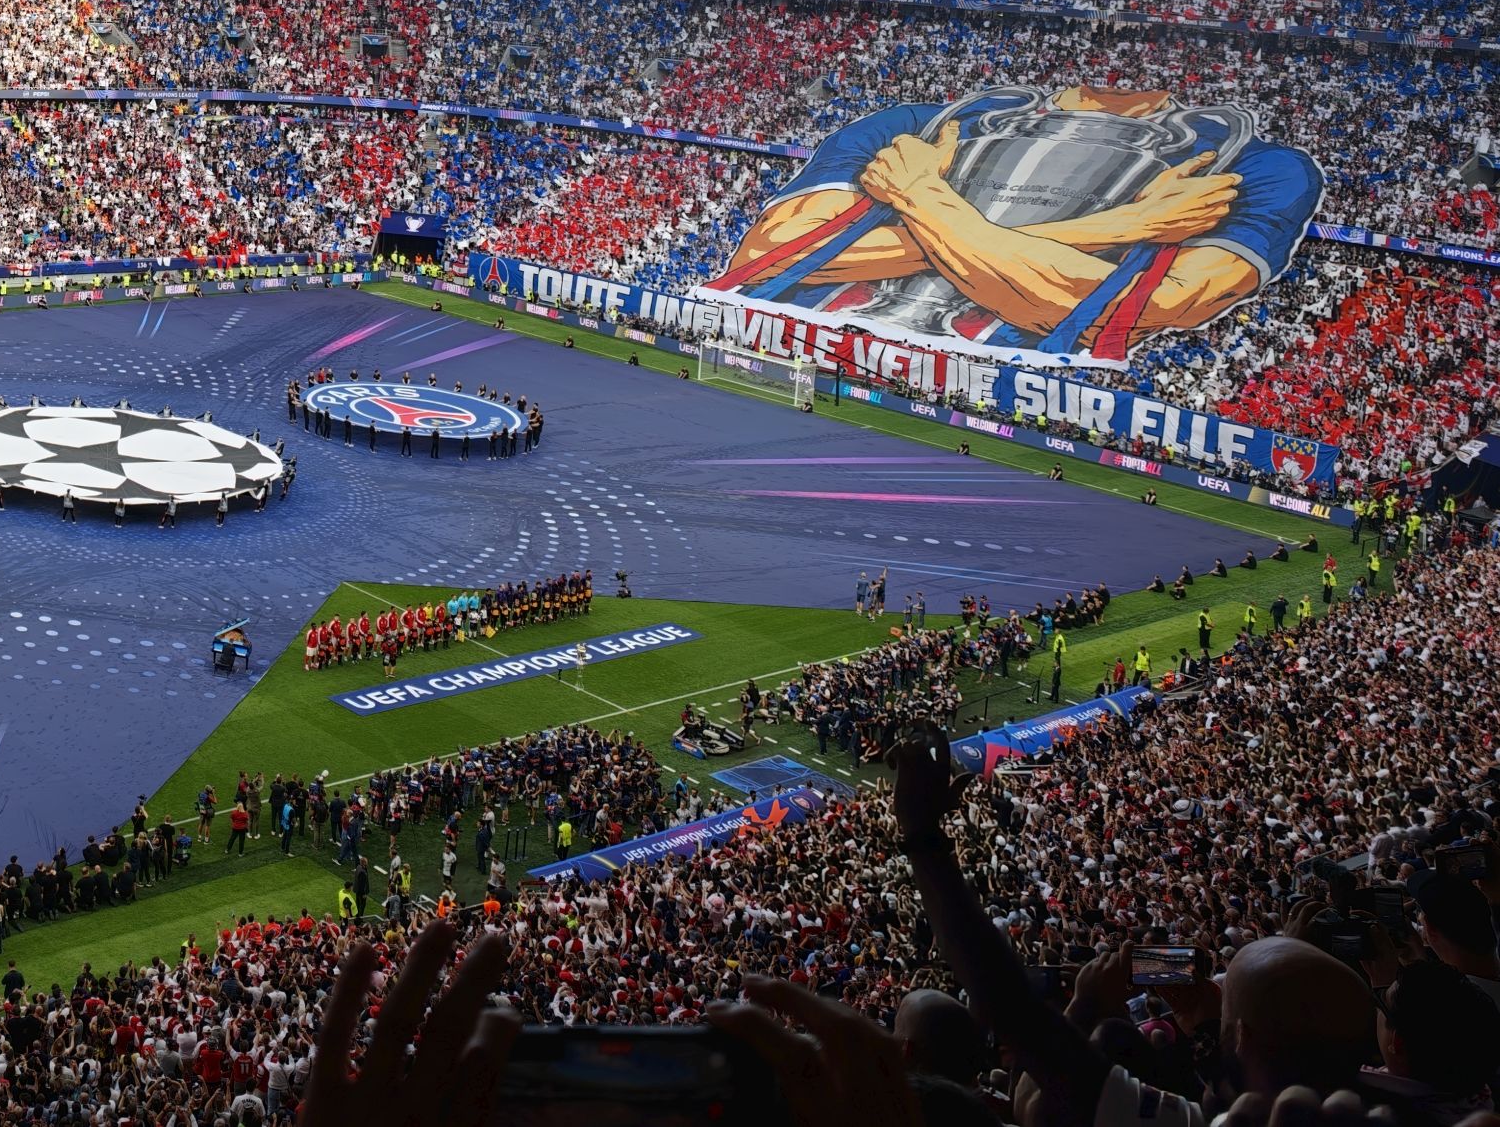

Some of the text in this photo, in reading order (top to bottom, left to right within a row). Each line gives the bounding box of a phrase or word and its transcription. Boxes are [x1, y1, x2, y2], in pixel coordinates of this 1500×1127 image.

[450, 105, 471, 113] FINAL
[696, 135, 771, 151] UEFA CHAMPIONS LEAGUE
[1049, 185, 1116, 208] CHAMPIONS
[217, 282, 236, 291] UEFA
[259, 278, 287, 289] #FOOTBALL
[306, 276, 323, 285] UEFA
[342, 273, 364, 283] WELCOME
[125, 287, 144, 297] UEFA
[164, 284, 187, 295] WELCOME
[441, 284, 471, 296] #FOOTBALL
[488, 293, 507, 306] UEFA
[526, 302, 560, 320] WELCOME ALL
[579, 316, 600, 330] UEFA
[623, 329, 657, 346] #FOOTBALL
[678, 341, 701, 356] UEFA
[518, 264, 631, 316] TOUTE
[638, 290, 723, 340] UNE
[736, 308, 844, 372] VILLE
[1013, 370, 1115, 434] SUR
[1130, 396, 1255, 473] ELLE
[724, 354, 763, 374] WELCOME ALL
[789, 370, 812, 386] UEFA
[317, 385, 421, 406] PARIS
[842, 385, 883, 405] #FOOTBALL
[910, 402, 936, 419] UEFA
[965, 415, 1014, 439] WELCOME ALL
[1045, 437, 1075, 454] UEFA
[1113, 452, 1162, 476] #FOOTBALL
[1197, 474, 1231, 493] UEFA
[1268, 491, 1331, 519] WELCOME ALL
[343, 625, 691, 711] UEFA CHAMPIONS LEAGUE
[1010, 728, 1036, 741] UEFA
[1034, 715, 1079, 736] CHAMPIONS
[621, 815, 752, 863] UEFA CHAMPIONS LEAGUE
